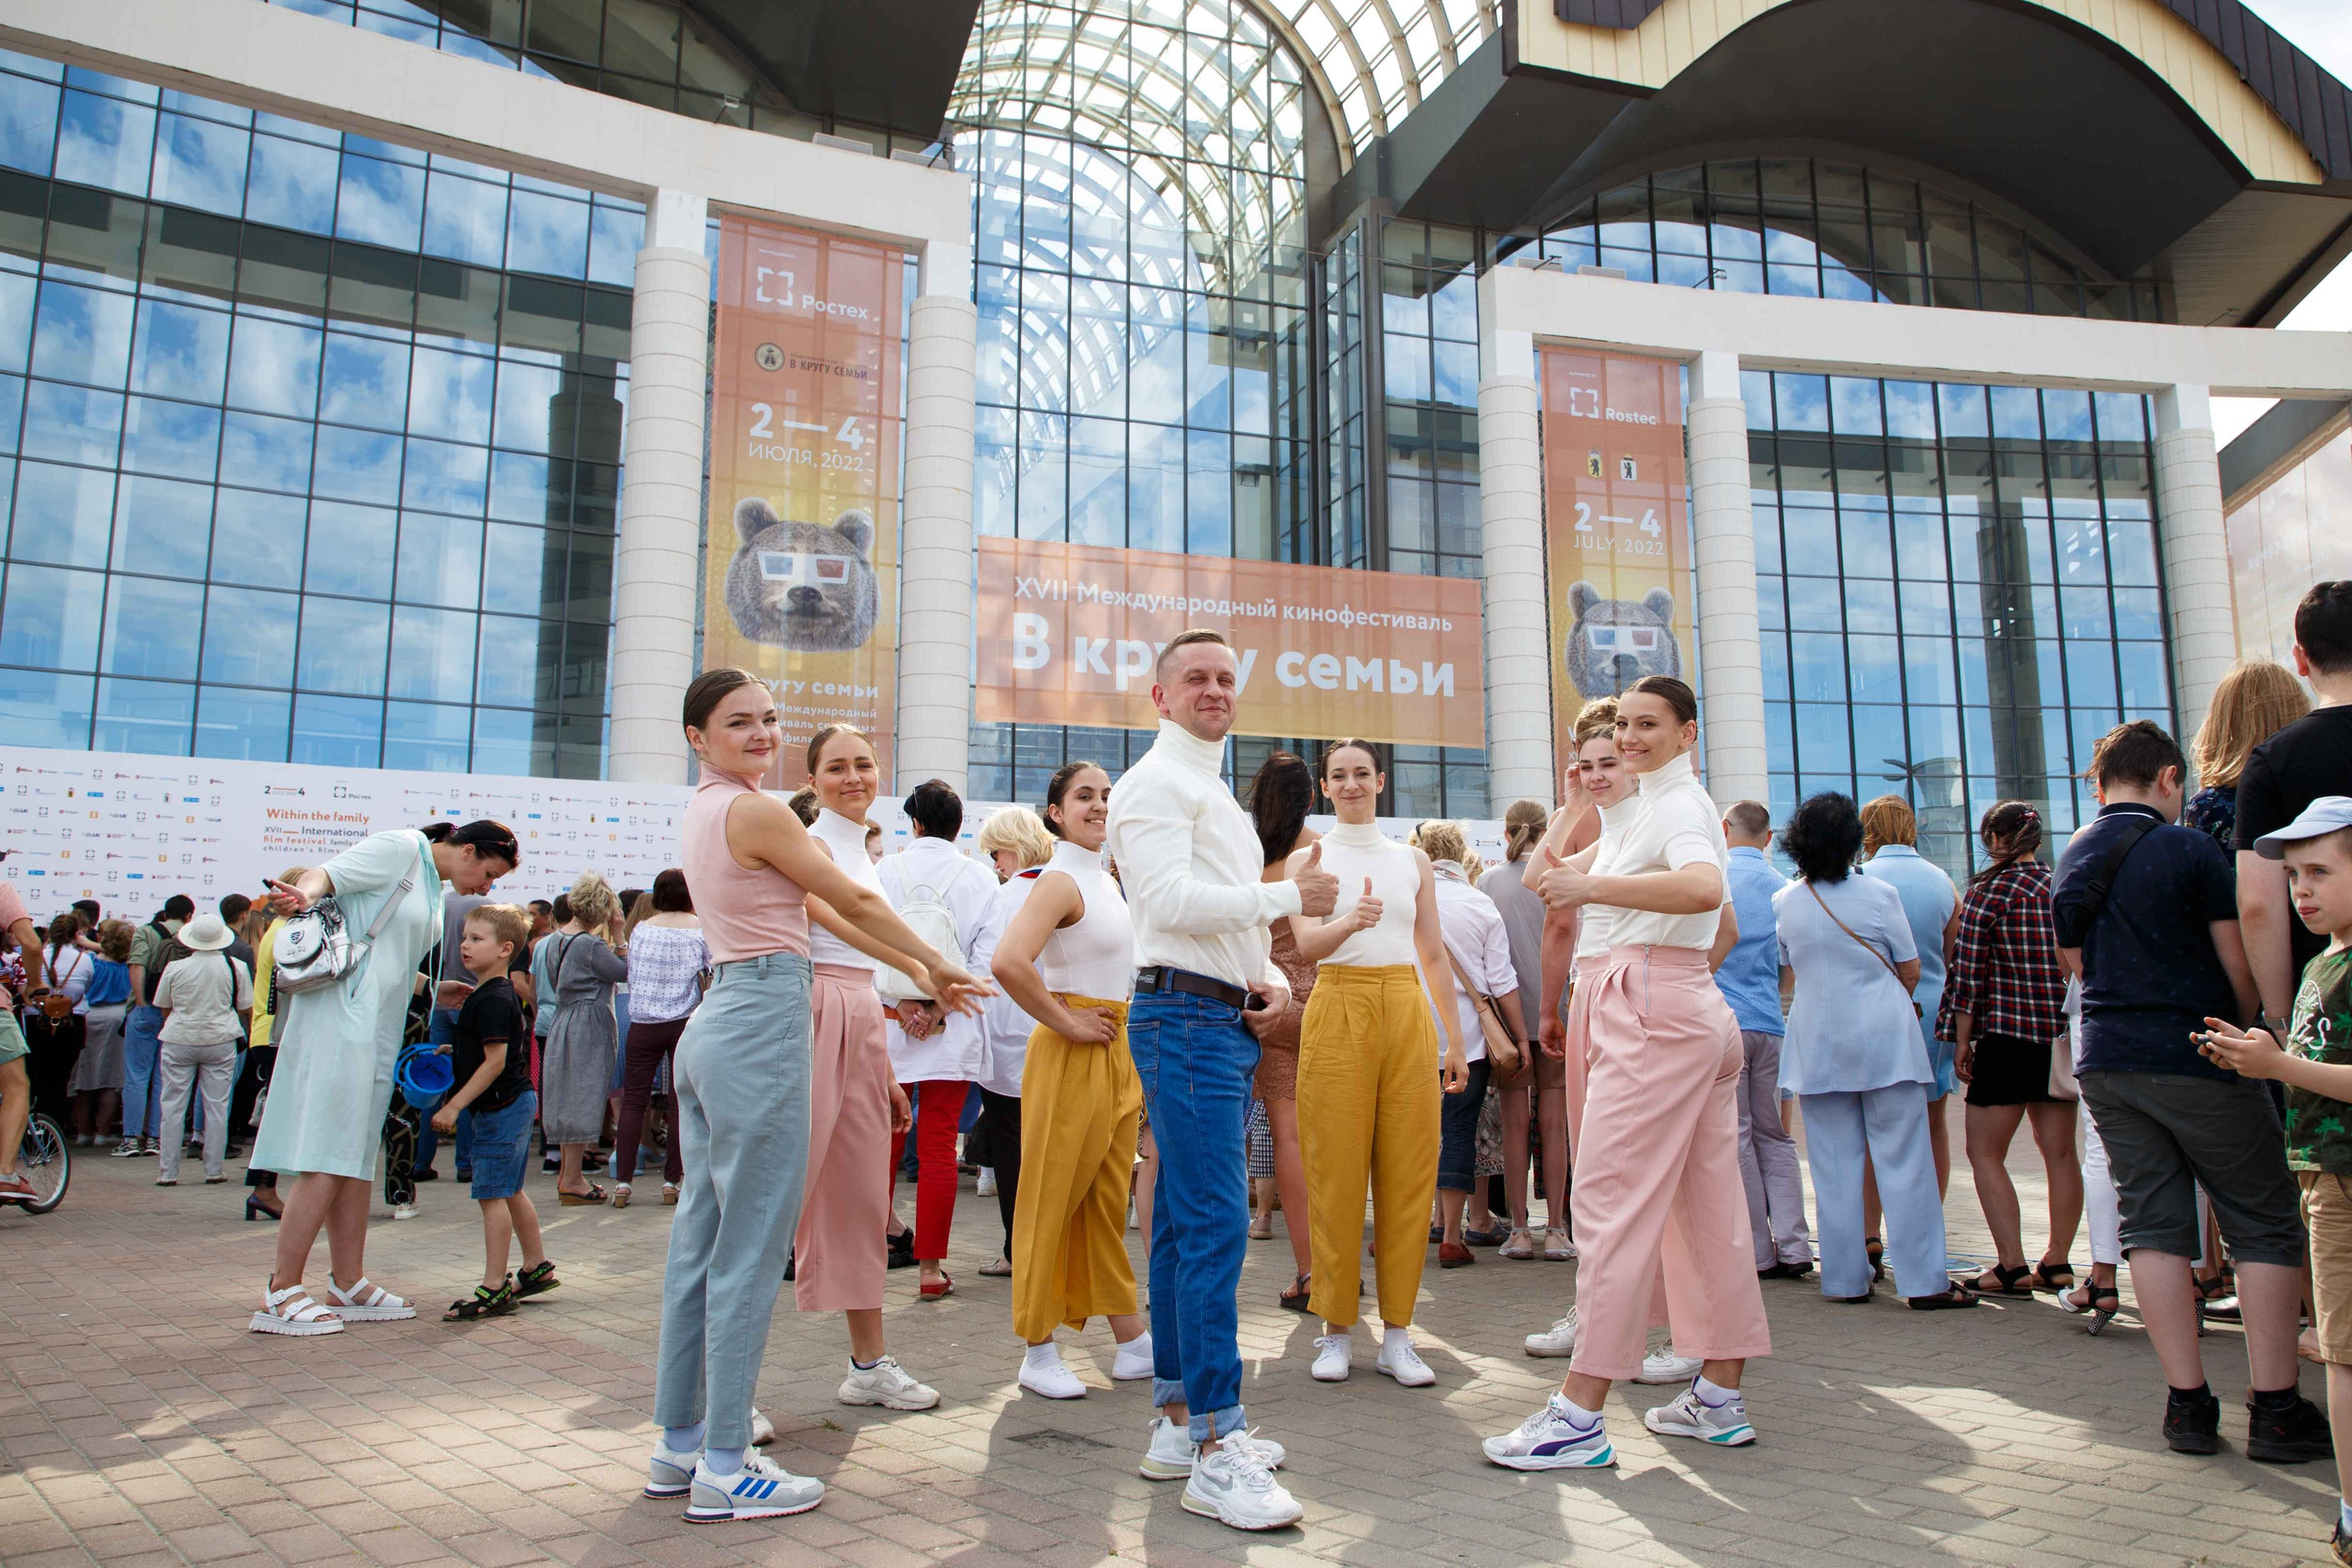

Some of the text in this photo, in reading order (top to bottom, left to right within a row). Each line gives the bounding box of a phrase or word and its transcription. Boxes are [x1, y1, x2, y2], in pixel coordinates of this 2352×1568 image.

[802, 294, 868, 320] Ростех
[790, 358, 797, 369] В
[800, 359, 831, 374] КРУГУ
[834, 366, 867, 380] СЕМЬИ
[1605, 407, 1657, 425] Rostec
[749, 402, 774, 439] 2
[835, 416, 865, 450] 4
[821, 452, 864, 472] 2022
[1574, 502, 1593, 532] 2
[1639, 508, 1661, 538] 4
[1625, 538, 1664, 556] 2022
[1014, 575, 1453, 633] XVII Международный кинофестиваль
[1012, 613, 1050, 670] В
[1274, 649, 1455, 698] семьи
[811, 681, 879, 698] семьи
[775, 701, 877, 719] Международный
[264, 784, 271, 795] 2
[298, 787, 305, 796] 4
[266, 807, 369, 825] Within the family
[263, 835, 283, 843] film
[287, 836, 327, 845] festival
[264, 826, 368, 838] XVII International
[318, 845, 340, 854] films
